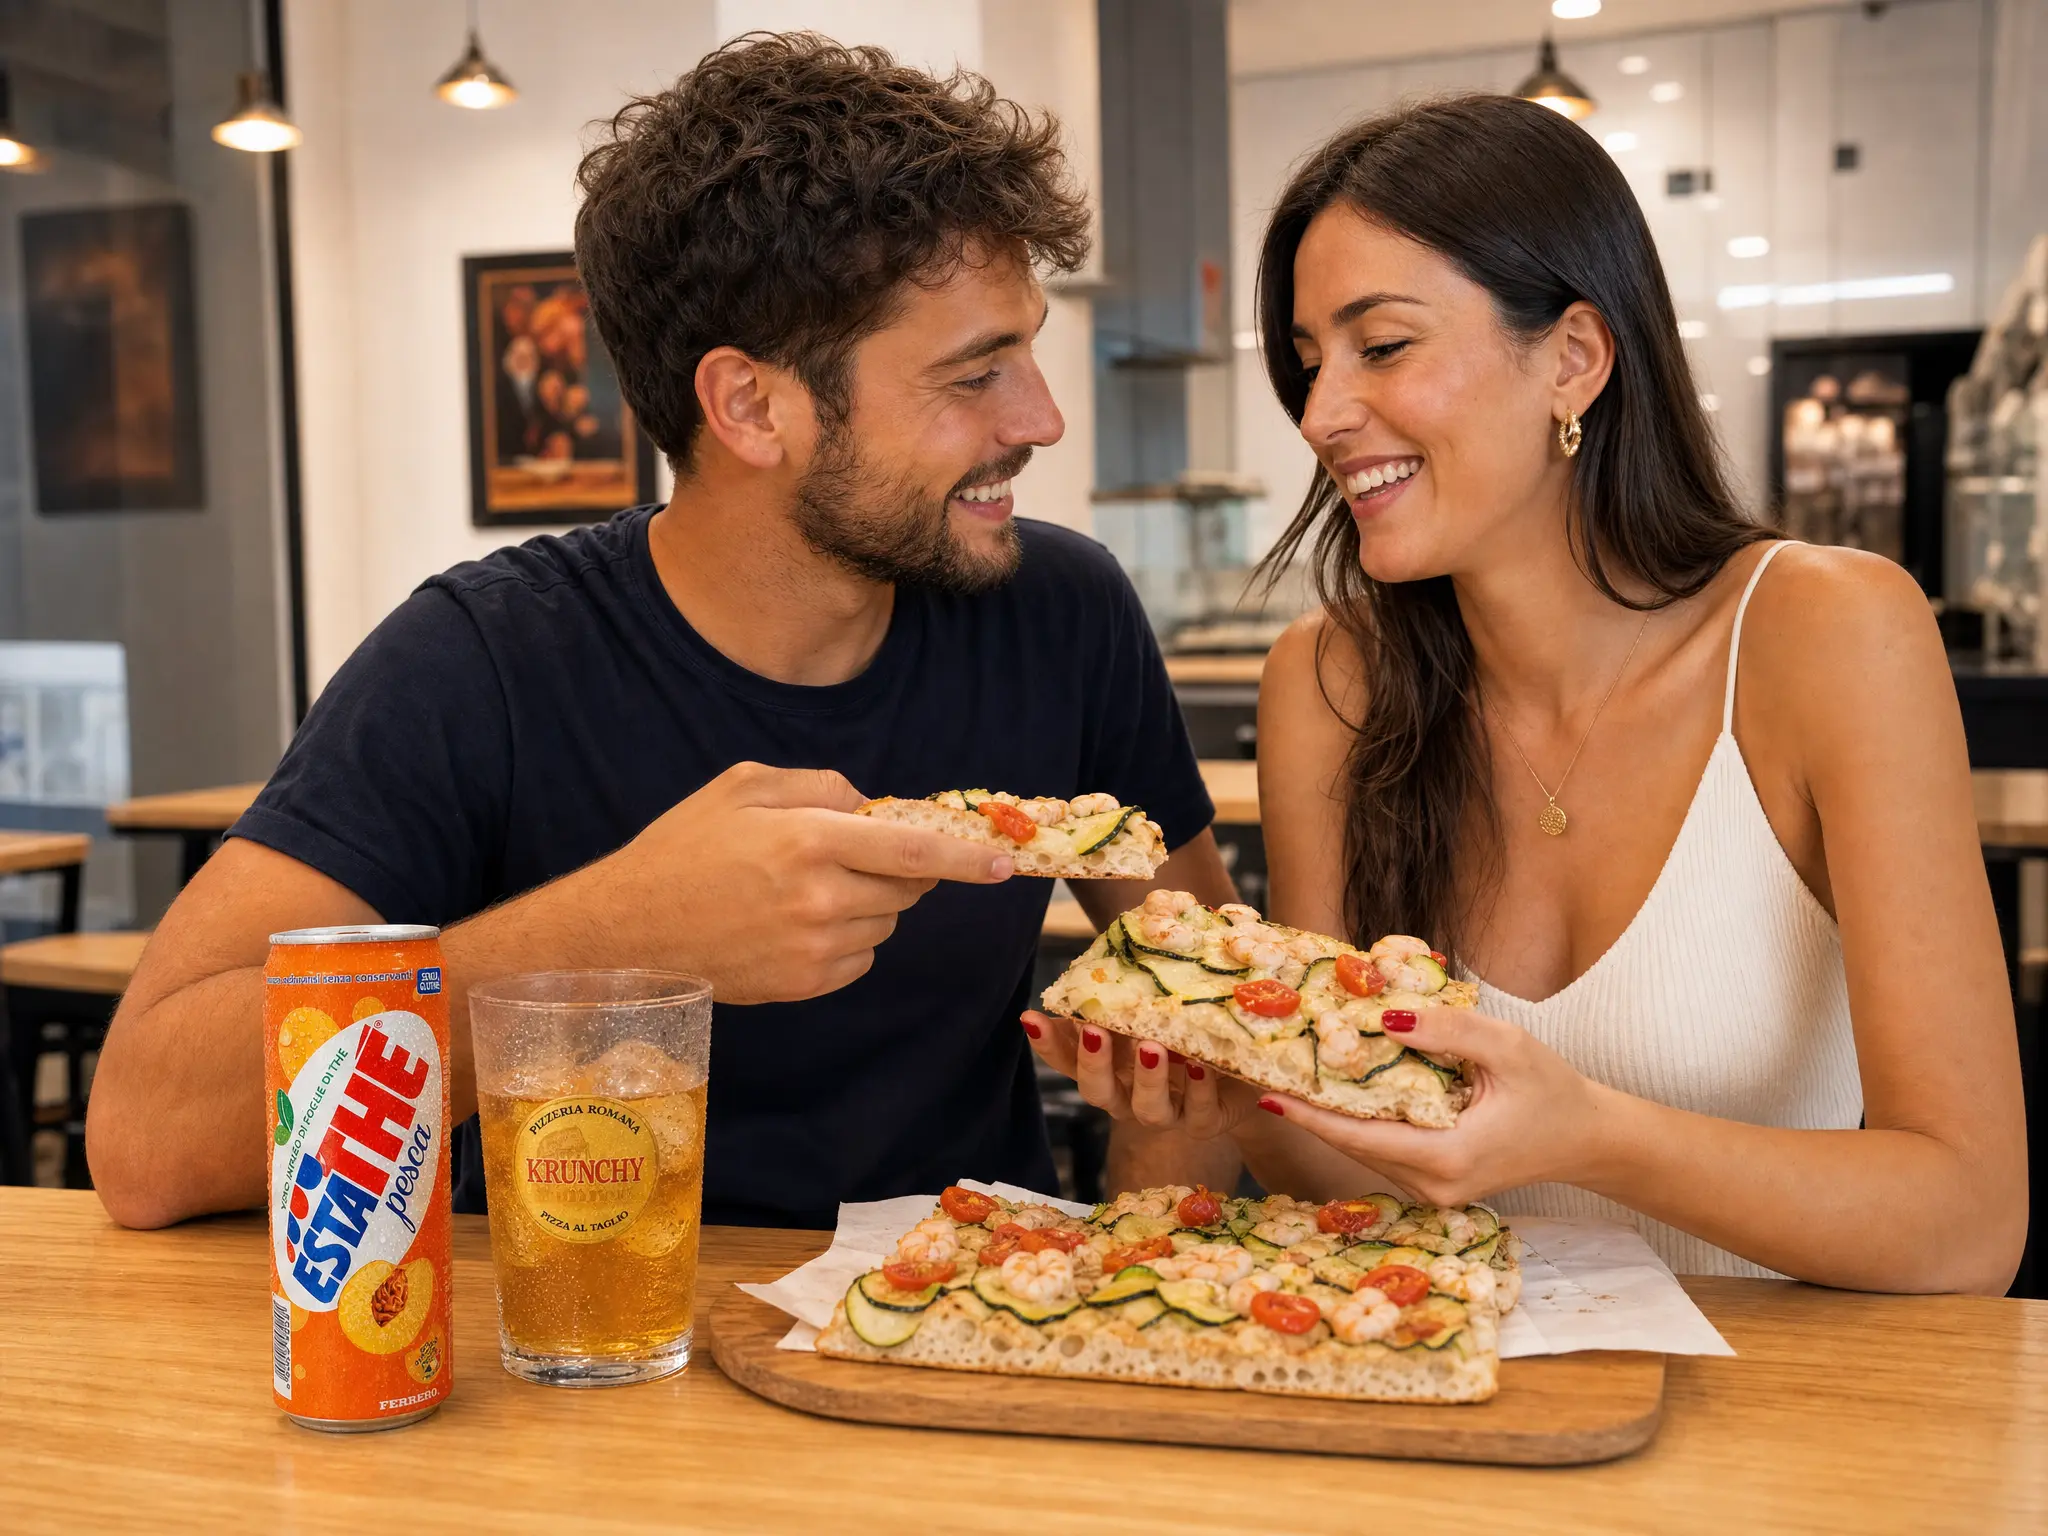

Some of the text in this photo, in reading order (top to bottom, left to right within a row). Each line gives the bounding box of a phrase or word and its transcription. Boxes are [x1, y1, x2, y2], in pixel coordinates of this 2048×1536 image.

[321, 1072, 334, 1085] DI
[328, 1048, 348, 1071] THE
[529, 1104, 641, 1136] PIZZERIA ROMANA
[385, 1123, 432, 1235] pesca
[526, 1156, 645, 1185] KRUNCHY
[540, 1210, 629, 1232] PIZZA AL TAGLIO
